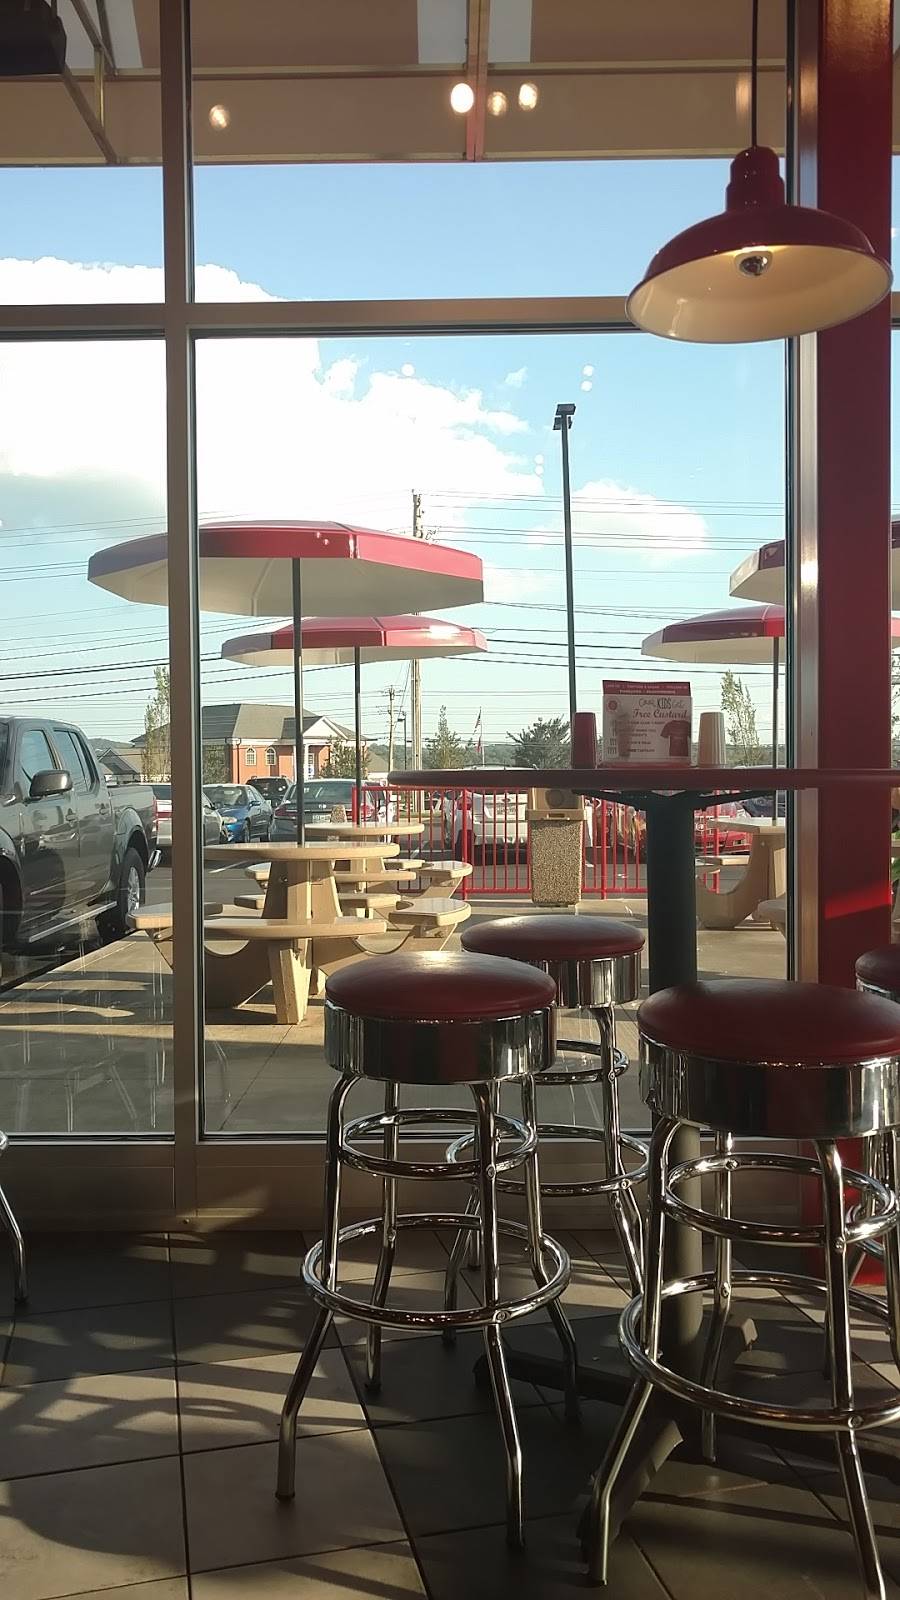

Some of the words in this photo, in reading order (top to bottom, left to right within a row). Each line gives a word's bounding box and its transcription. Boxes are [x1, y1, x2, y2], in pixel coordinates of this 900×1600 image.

[657, 697, 672, 710] KIDS
[633, 708, 651, 719] Free
[653, 709, 688, 719] Custard
